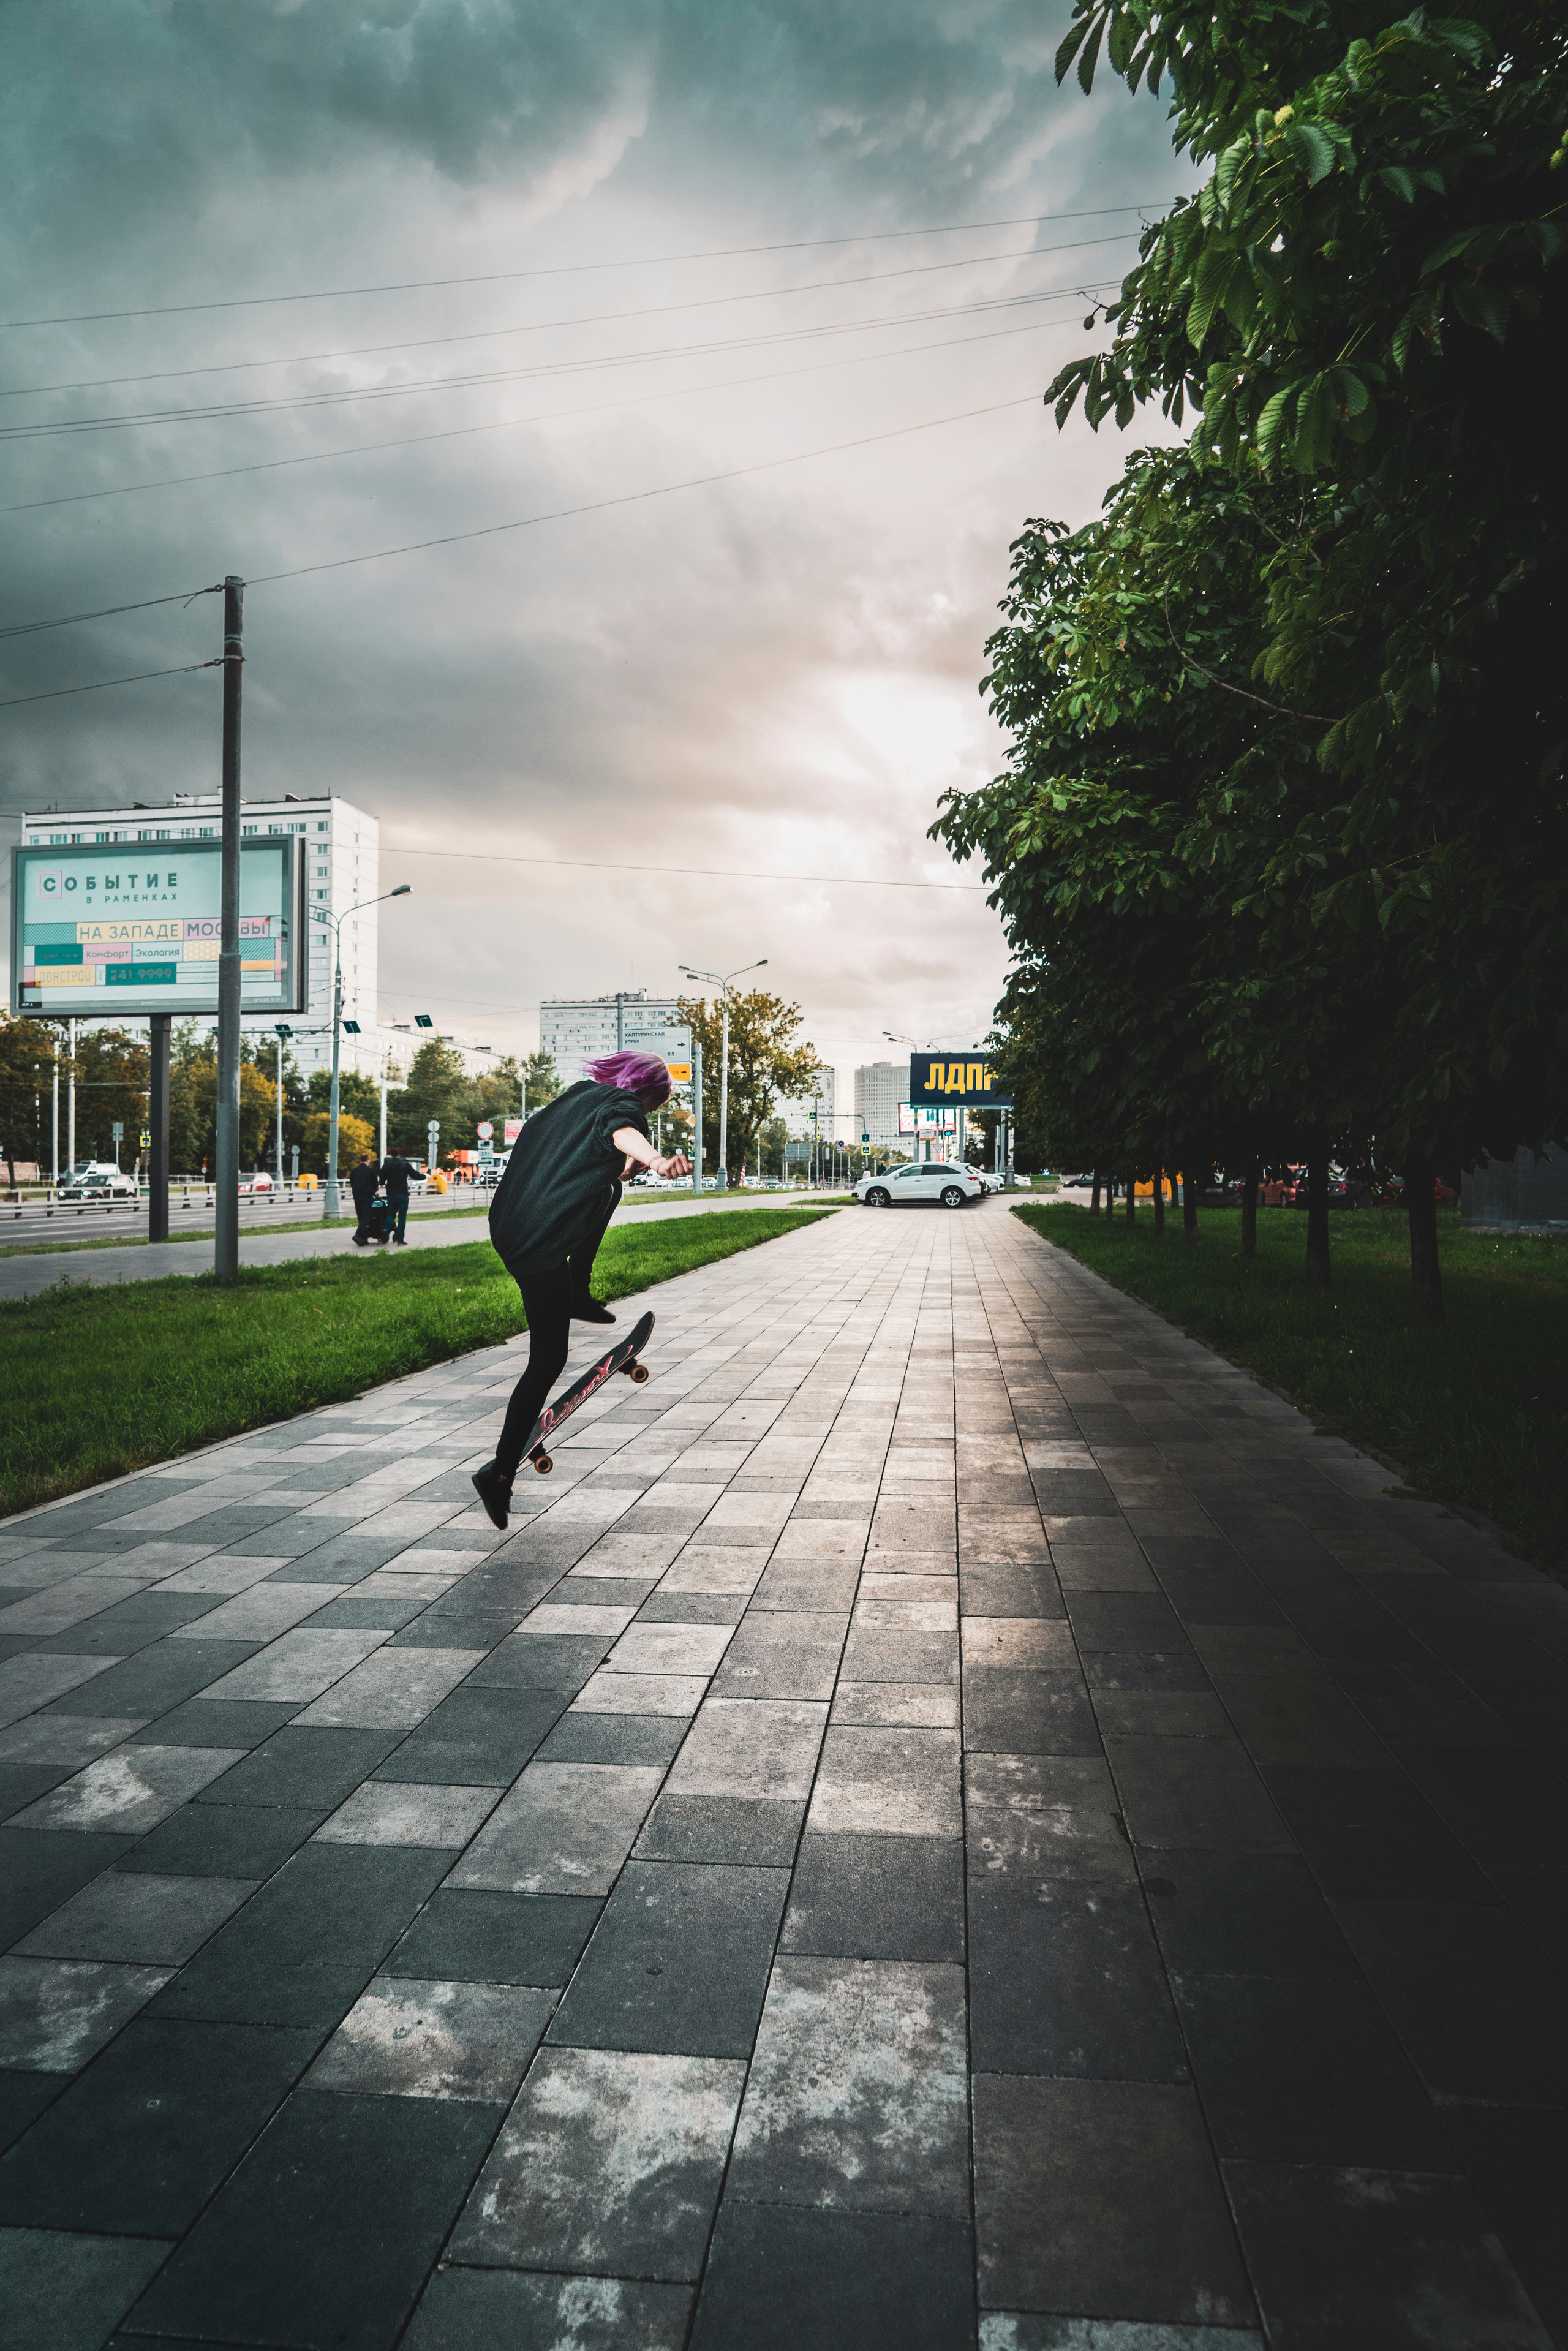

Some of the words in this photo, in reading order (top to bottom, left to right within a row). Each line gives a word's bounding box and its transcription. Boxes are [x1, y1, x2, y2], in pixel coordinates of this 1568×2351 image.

[43, 873, 178, 892] СОБЫТИЕ
[105, 893, 177, 903] РАМЕНКАХ
[80, 927, 102, 940] НА
[109, 924, 179, 940] ЗАПАДЕ
[187, 921, 265, 937] МОСВЫ
[86, 951, 129, 959] Комфорт
[135, 949, 180, 957] Экология
[39, 967, 91, 983] ДОНСТРОЙ
[110, 970, 133, 981] 241
[138, 968, 173, 980] 9999
